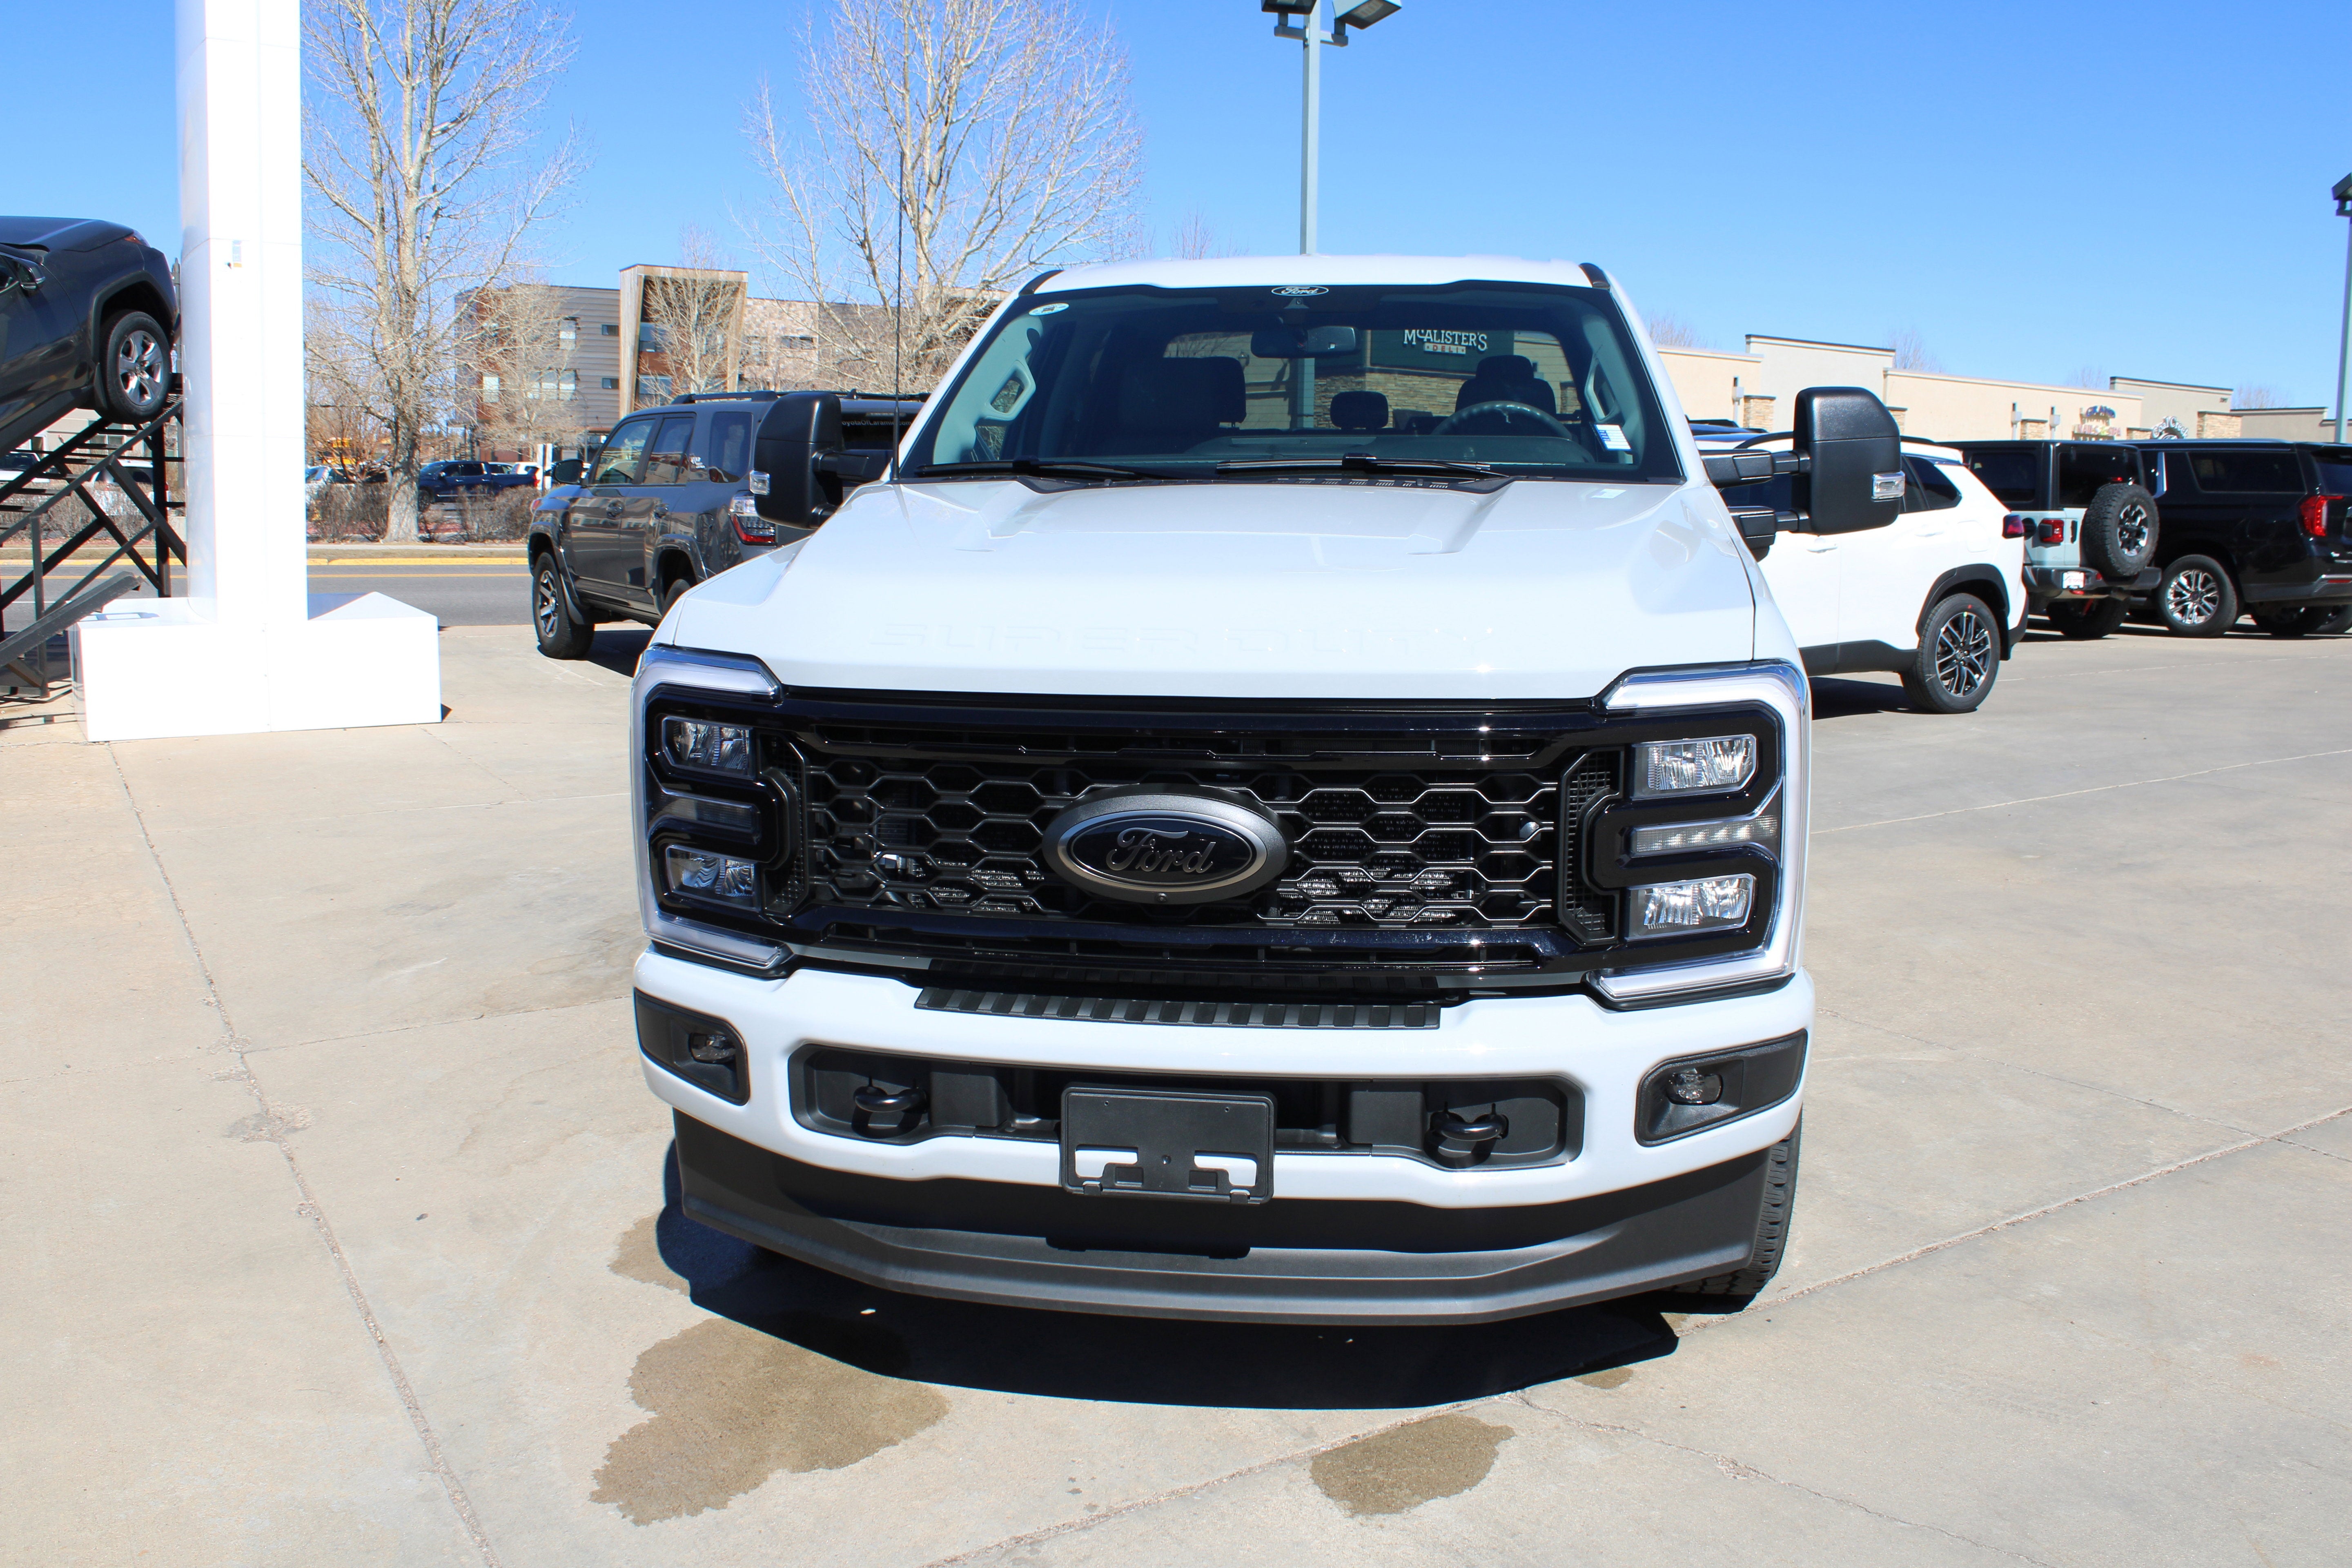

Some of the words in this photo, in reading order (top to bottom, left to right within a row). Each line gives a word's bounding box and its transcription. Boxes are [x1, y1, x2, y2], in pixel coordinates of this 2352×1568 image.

[2152, 416, 2169, 439] Coal
[2169, 416, 2189, 439] Creek
[868, 623, 1198, 655] SUPER
[1223, 627, 1496, 657] DUTY
[1106, 827, 1216, 873] Ford
